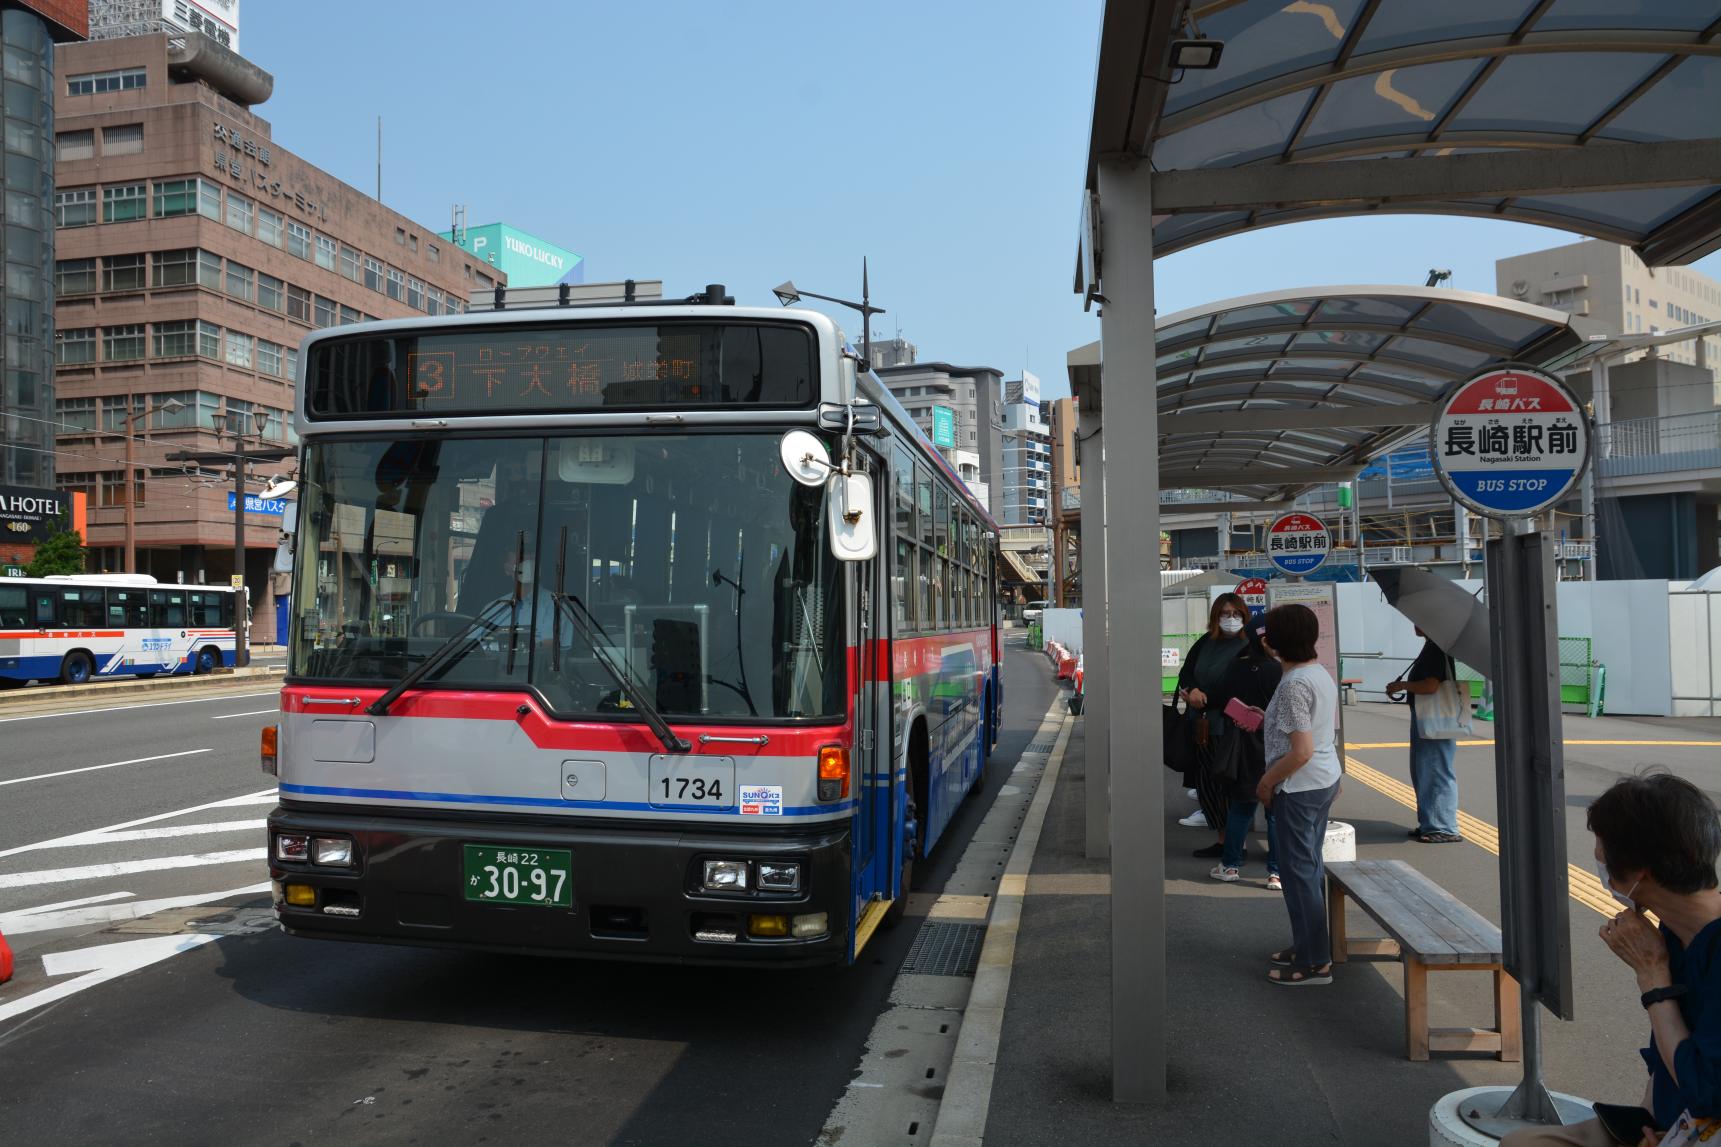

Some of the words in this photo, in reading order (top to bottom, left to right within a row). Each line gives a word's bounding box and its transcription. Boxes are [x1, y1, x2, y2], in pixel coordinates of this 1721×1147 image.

[174, 0, 231, 49] 三菱電機
[213, 122, 271, 167] 交通会館
[213, 151, 327, 224] 県営バスターミナル
[473, 236, 488, 253] P
[504, 235, 533, 257] YUKO
[533, 247, 565, 270] LUCKY
[418, 360, 445, 392] 3
[472, 360, 601, 399] 下大橋
[1478, 397, 1542, 411] 長崎バス
[1444, 423, 1579, 457] 長崎駅前
[1479, 455, 1514, 465] Nagasaki
[1514, 455, 1542, 463] Station
[1476, 479, 1505, 492] BUS
[1508, 479, 1548, 492] STOP
[10, 496, 63, 515] HOTEL
[12, 521, 29, 533] 160
[1270, 535, 1327, 551] 長崎駅前
[661, 777, 723, 801] 1734
[496, 852, 519, 864] 長崎
[521, 853, 539, 866] 22
[470, 875, 481, 886] か
[483, 865, 567, 902] 30-97
